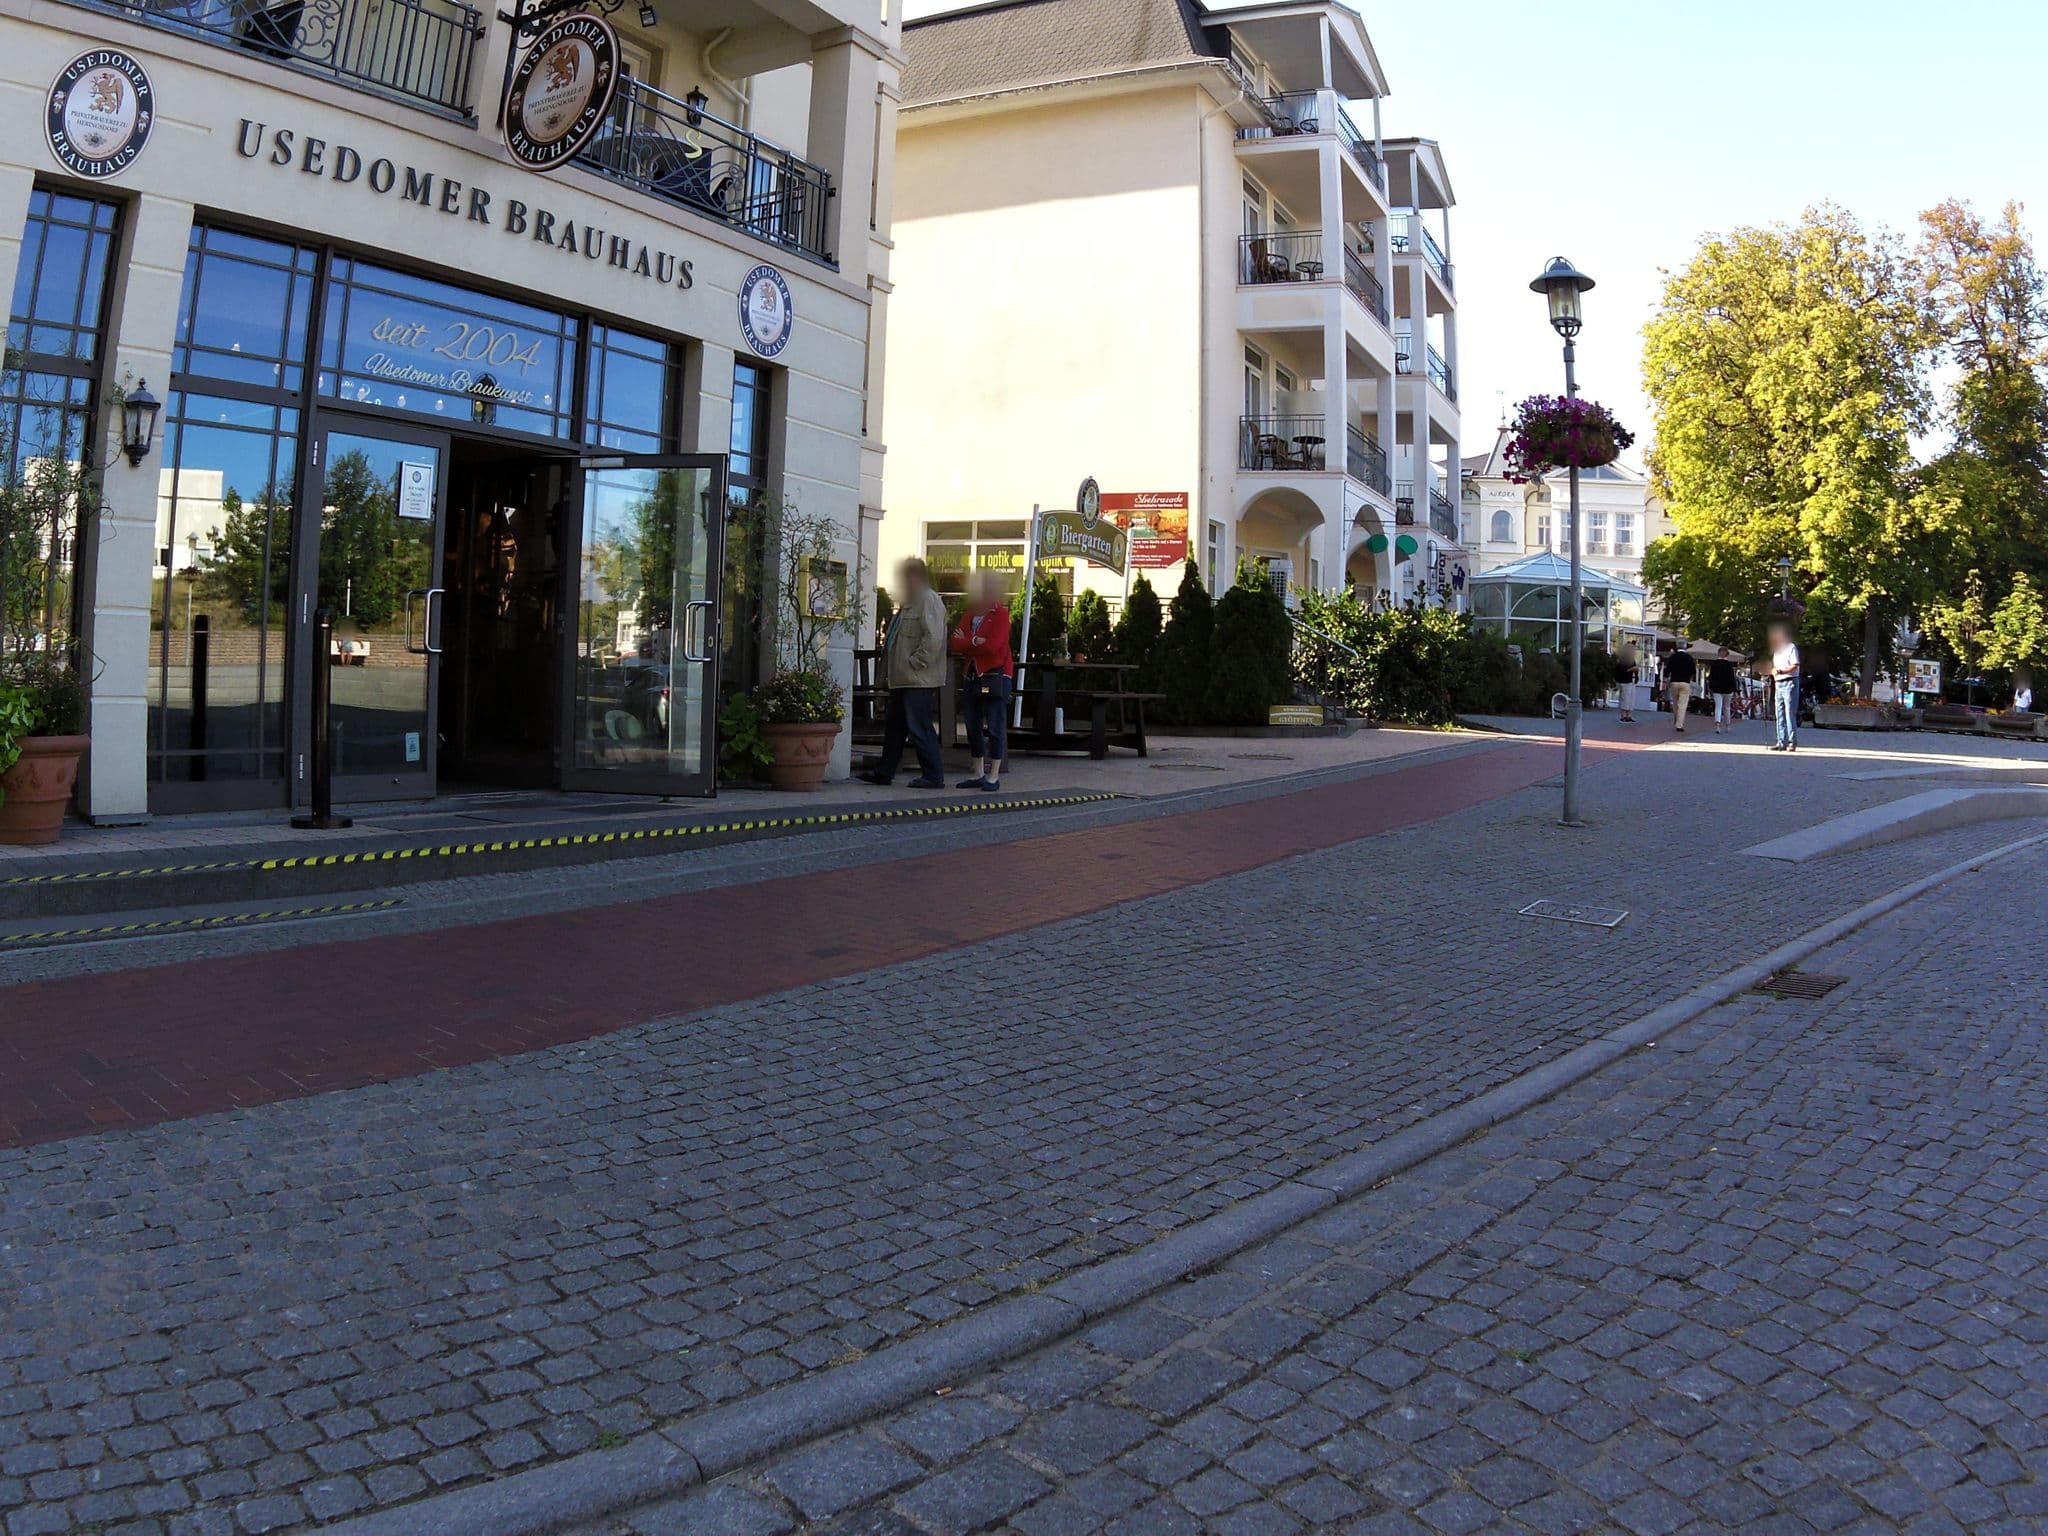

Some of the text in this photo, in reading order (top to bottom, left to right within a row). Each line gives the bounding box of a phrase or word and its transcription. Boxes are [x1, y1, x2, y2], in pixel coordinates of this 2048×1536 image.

[521, 21, 606, 75] USEDOMER
[66, 52, 148, 97] USEDOMER
[52, 131, 135, 174] BRAUHAUS
[512, 107, 596, 161] BRAUHAUS
[237, 118, 694, 289] USEDOMER BRAUHAUS
[746, 267, 789, 300] USEDOMER
[371, 318, 542, 376] seit 2004
[744, 323, 787, 355] BRAUHAUS
[364, 352, 534, 402] Usedomer Braukunst
[988, 551, 1010, 570] optik
[1061, 524, 1111, 555] Biergarten
[1438, 552, 1446, 594] DEPOT
